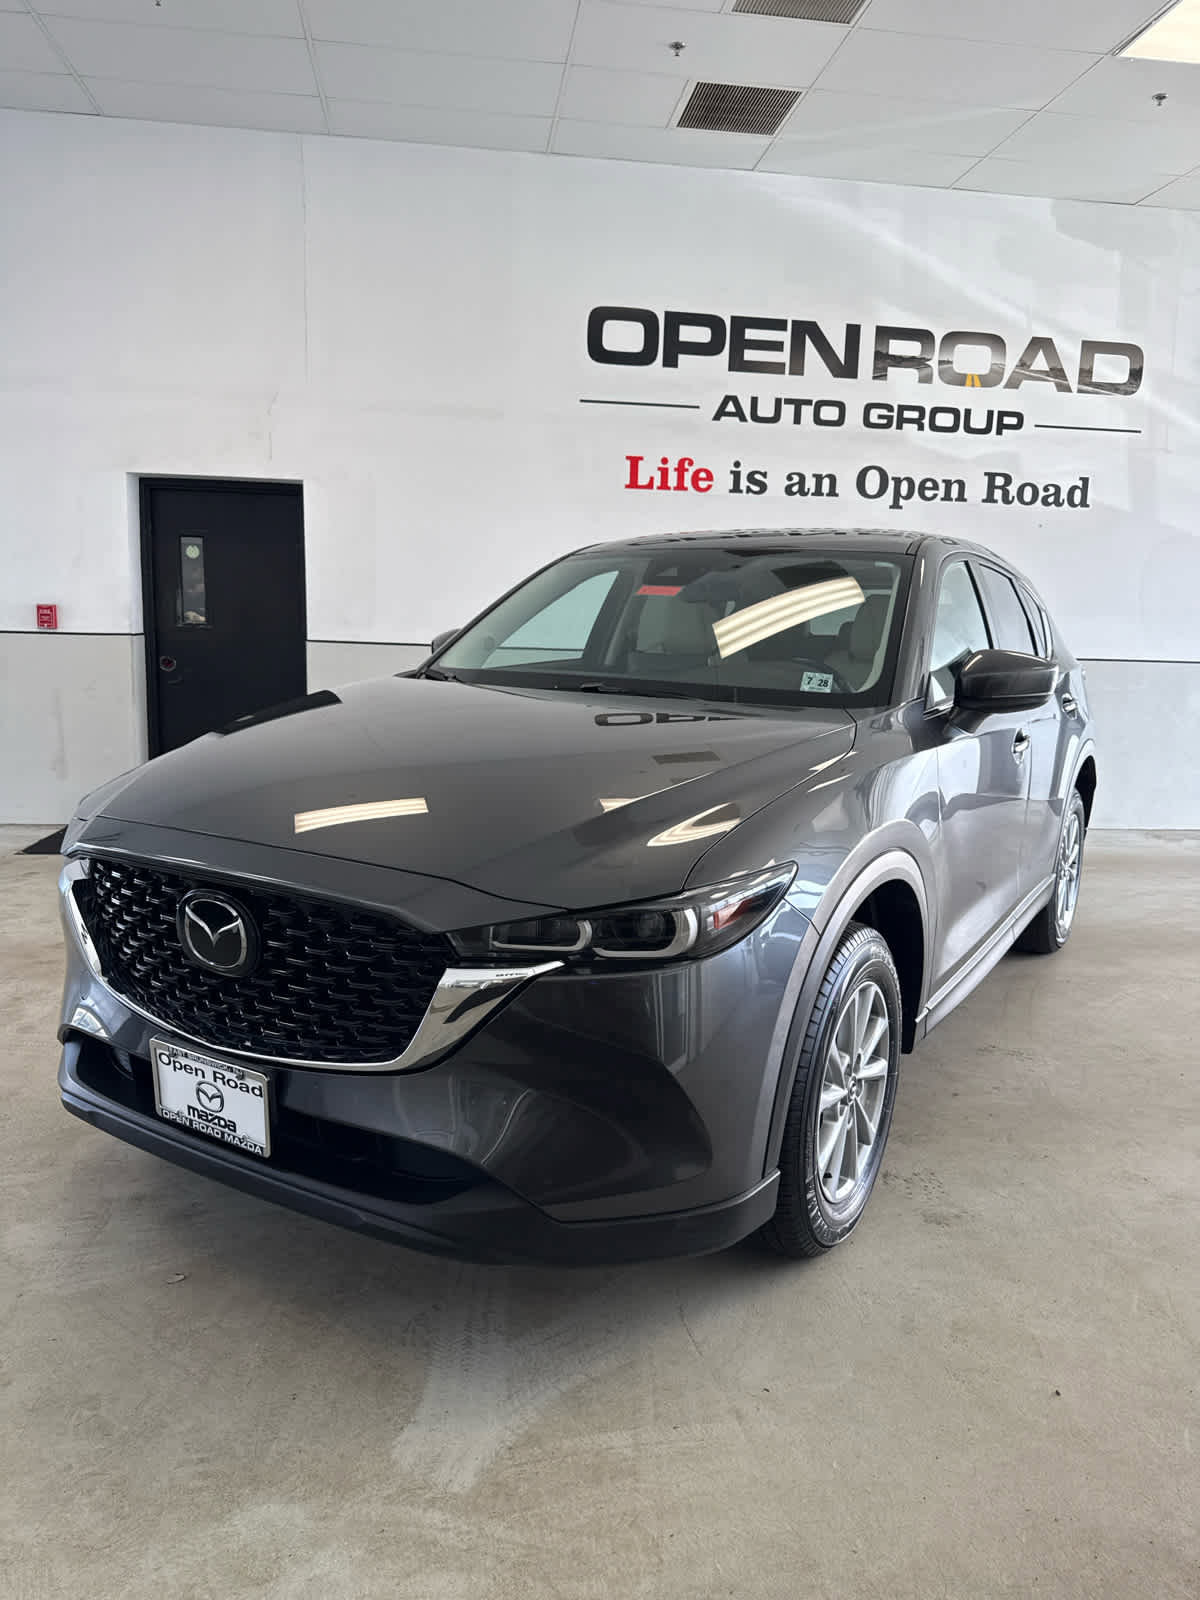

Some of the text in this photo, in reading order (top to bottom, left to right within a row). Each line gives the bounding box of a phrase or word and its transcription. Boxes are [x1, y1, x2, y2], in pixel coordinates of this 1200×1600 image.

[587, 306, 1145, 396] OPEN ROAD
[712, 394, 1025, 436] AUTO GROUP
[624, 455, 1091, 510] Life is an Open Road
[158, 1052, 205, 1079] Open
[212, 1070, 263, 1098] Road
[162, 1109, 262, 1154] OPEN ROAD MAZDA
